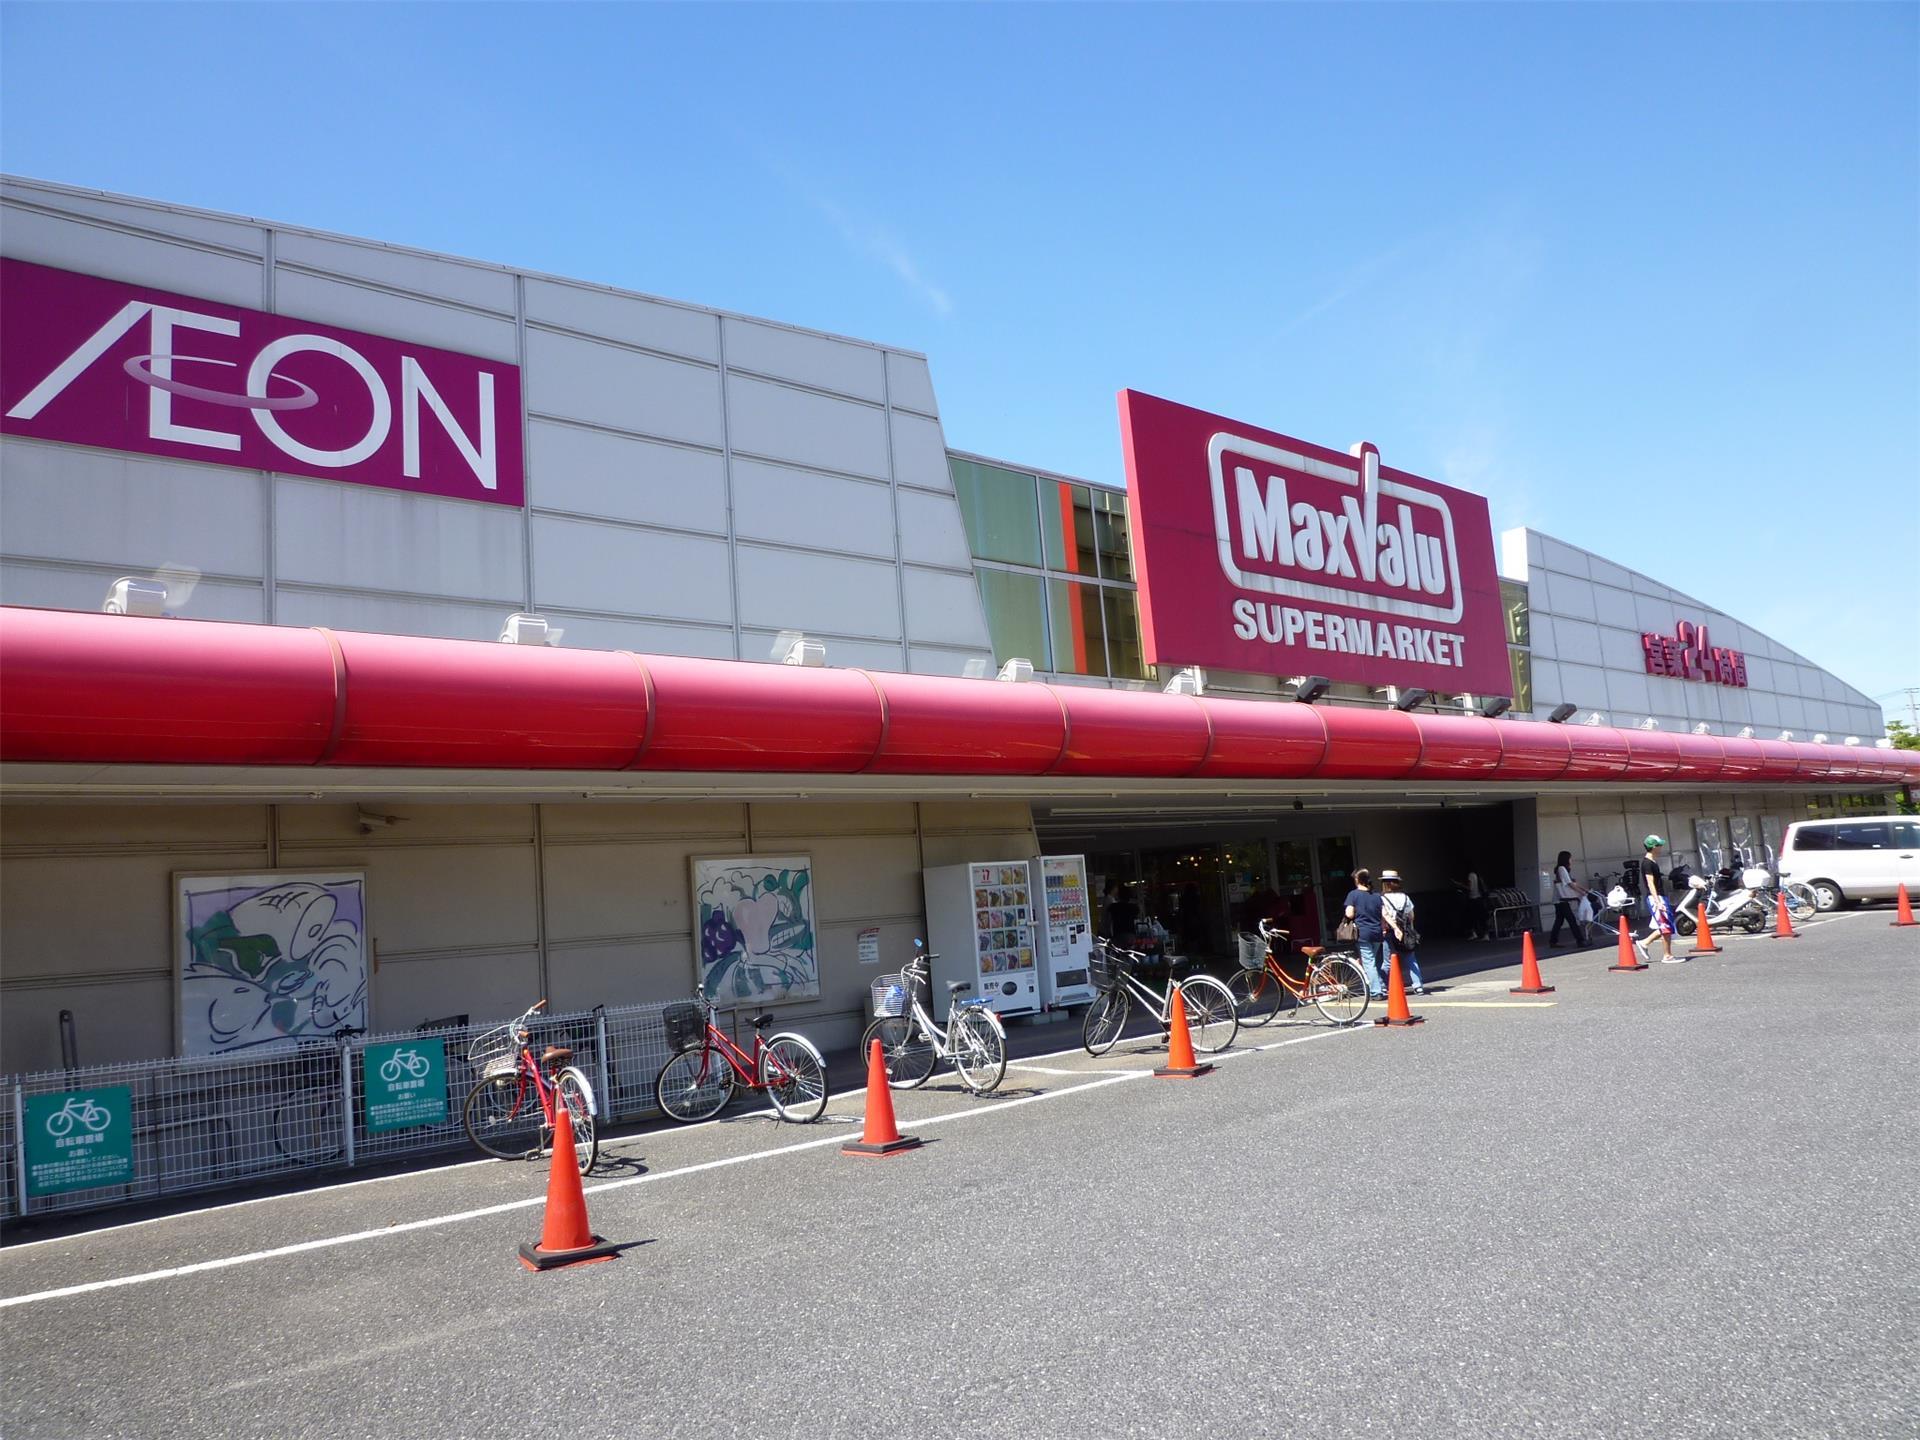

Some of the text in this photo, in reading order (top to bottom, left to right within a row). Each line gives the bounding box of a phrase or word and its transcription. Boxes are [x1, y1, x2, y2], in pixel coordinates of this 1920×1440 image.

[1234, 451, 1446, 595] MaxValu
[1232, 599, 1465, 667] SUPERMARKET
[56, 1133, 104, 1147] 自転車置場
